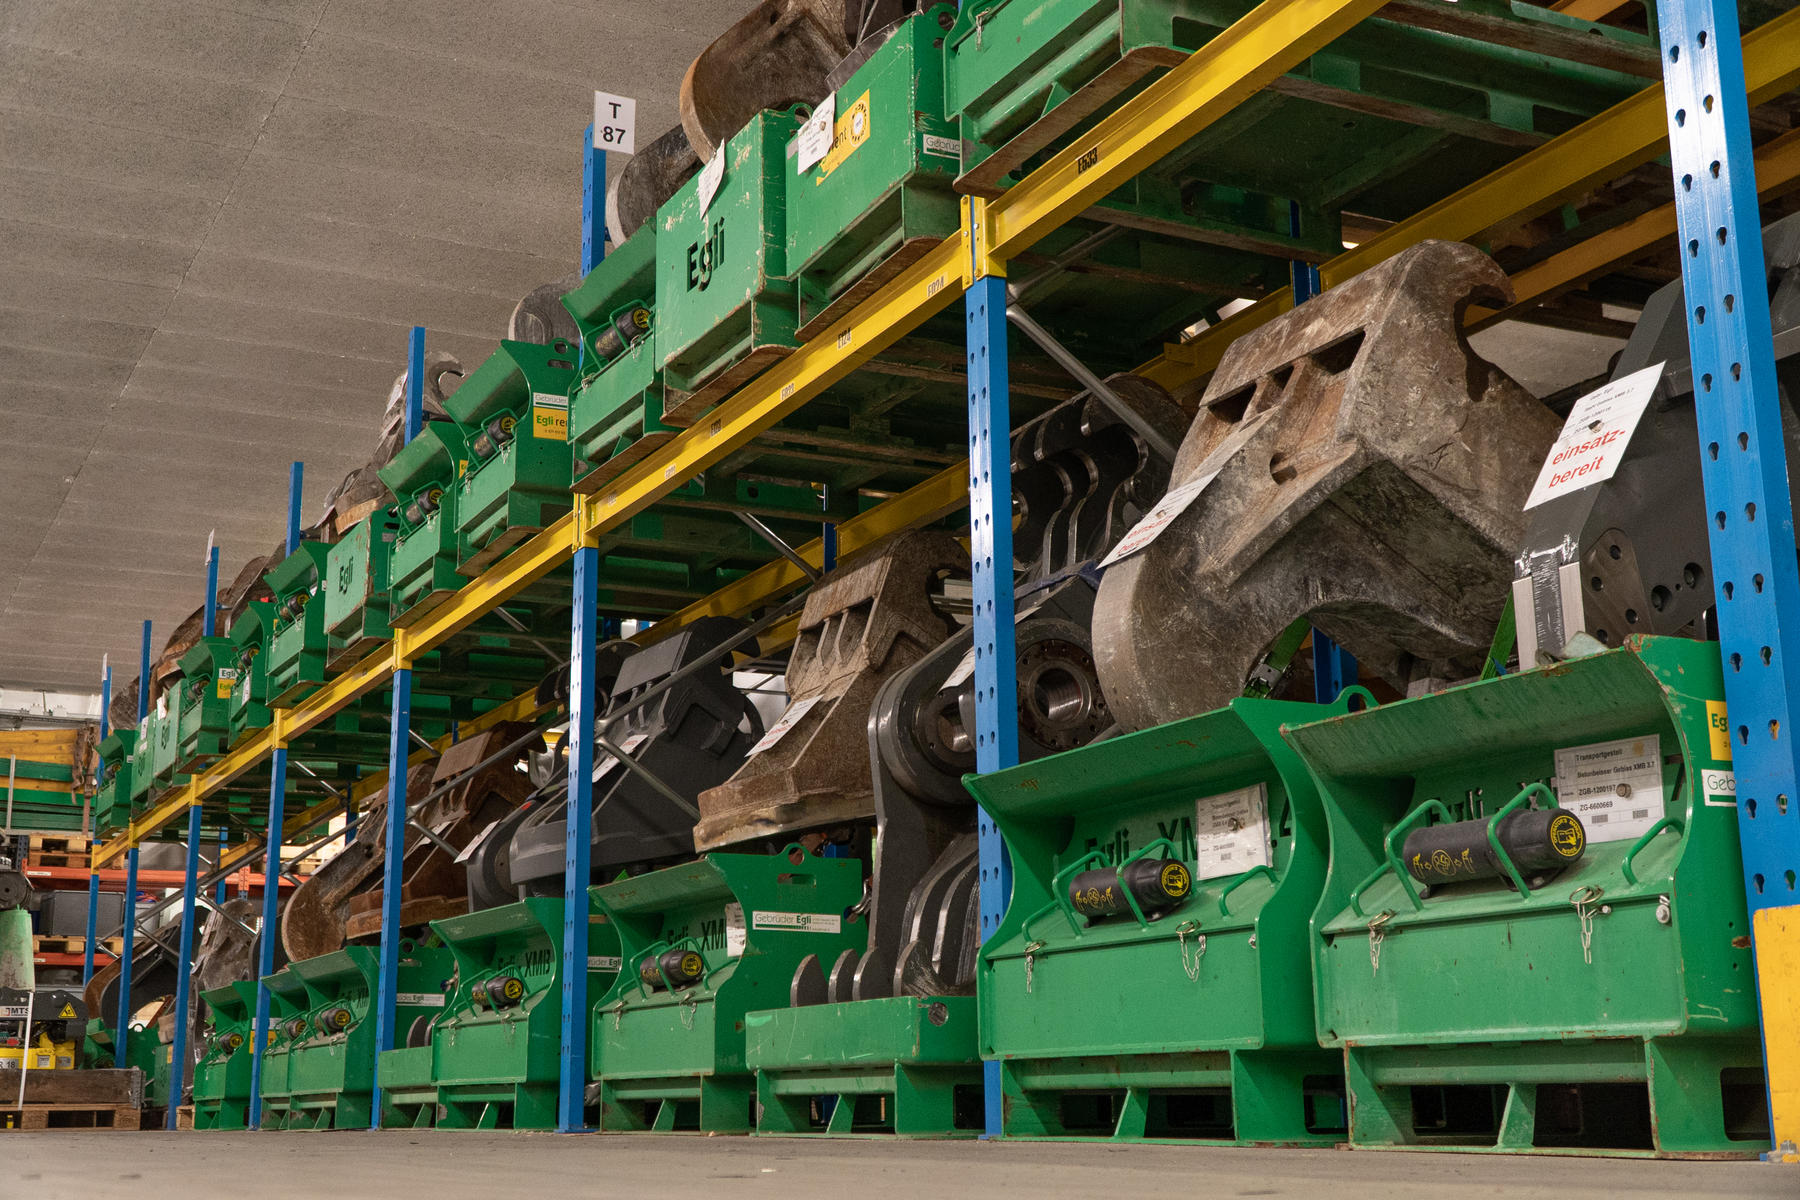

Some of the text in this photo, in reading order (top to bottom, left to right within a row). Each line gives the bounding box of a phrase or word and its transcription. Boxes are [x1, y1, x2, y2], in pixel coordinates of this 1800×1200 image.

[609, 102, 621, 119] T
[603, 126, 626, 144] 87
[687, 217, 725, 292] Egli
[536, 415, 554, 427] Egli
[1552, 429, 1626, 465] einsatz-
[1548, 456, 1604, 488] bereit
[1712, 713, 1728, 732] Eg
[1707, 775, 1736, 791] Geb
[755, 913, 794, 924] Gebrüder
[796, 915, 812, 926] Egli
[608, 957, 621, 968] Egli
